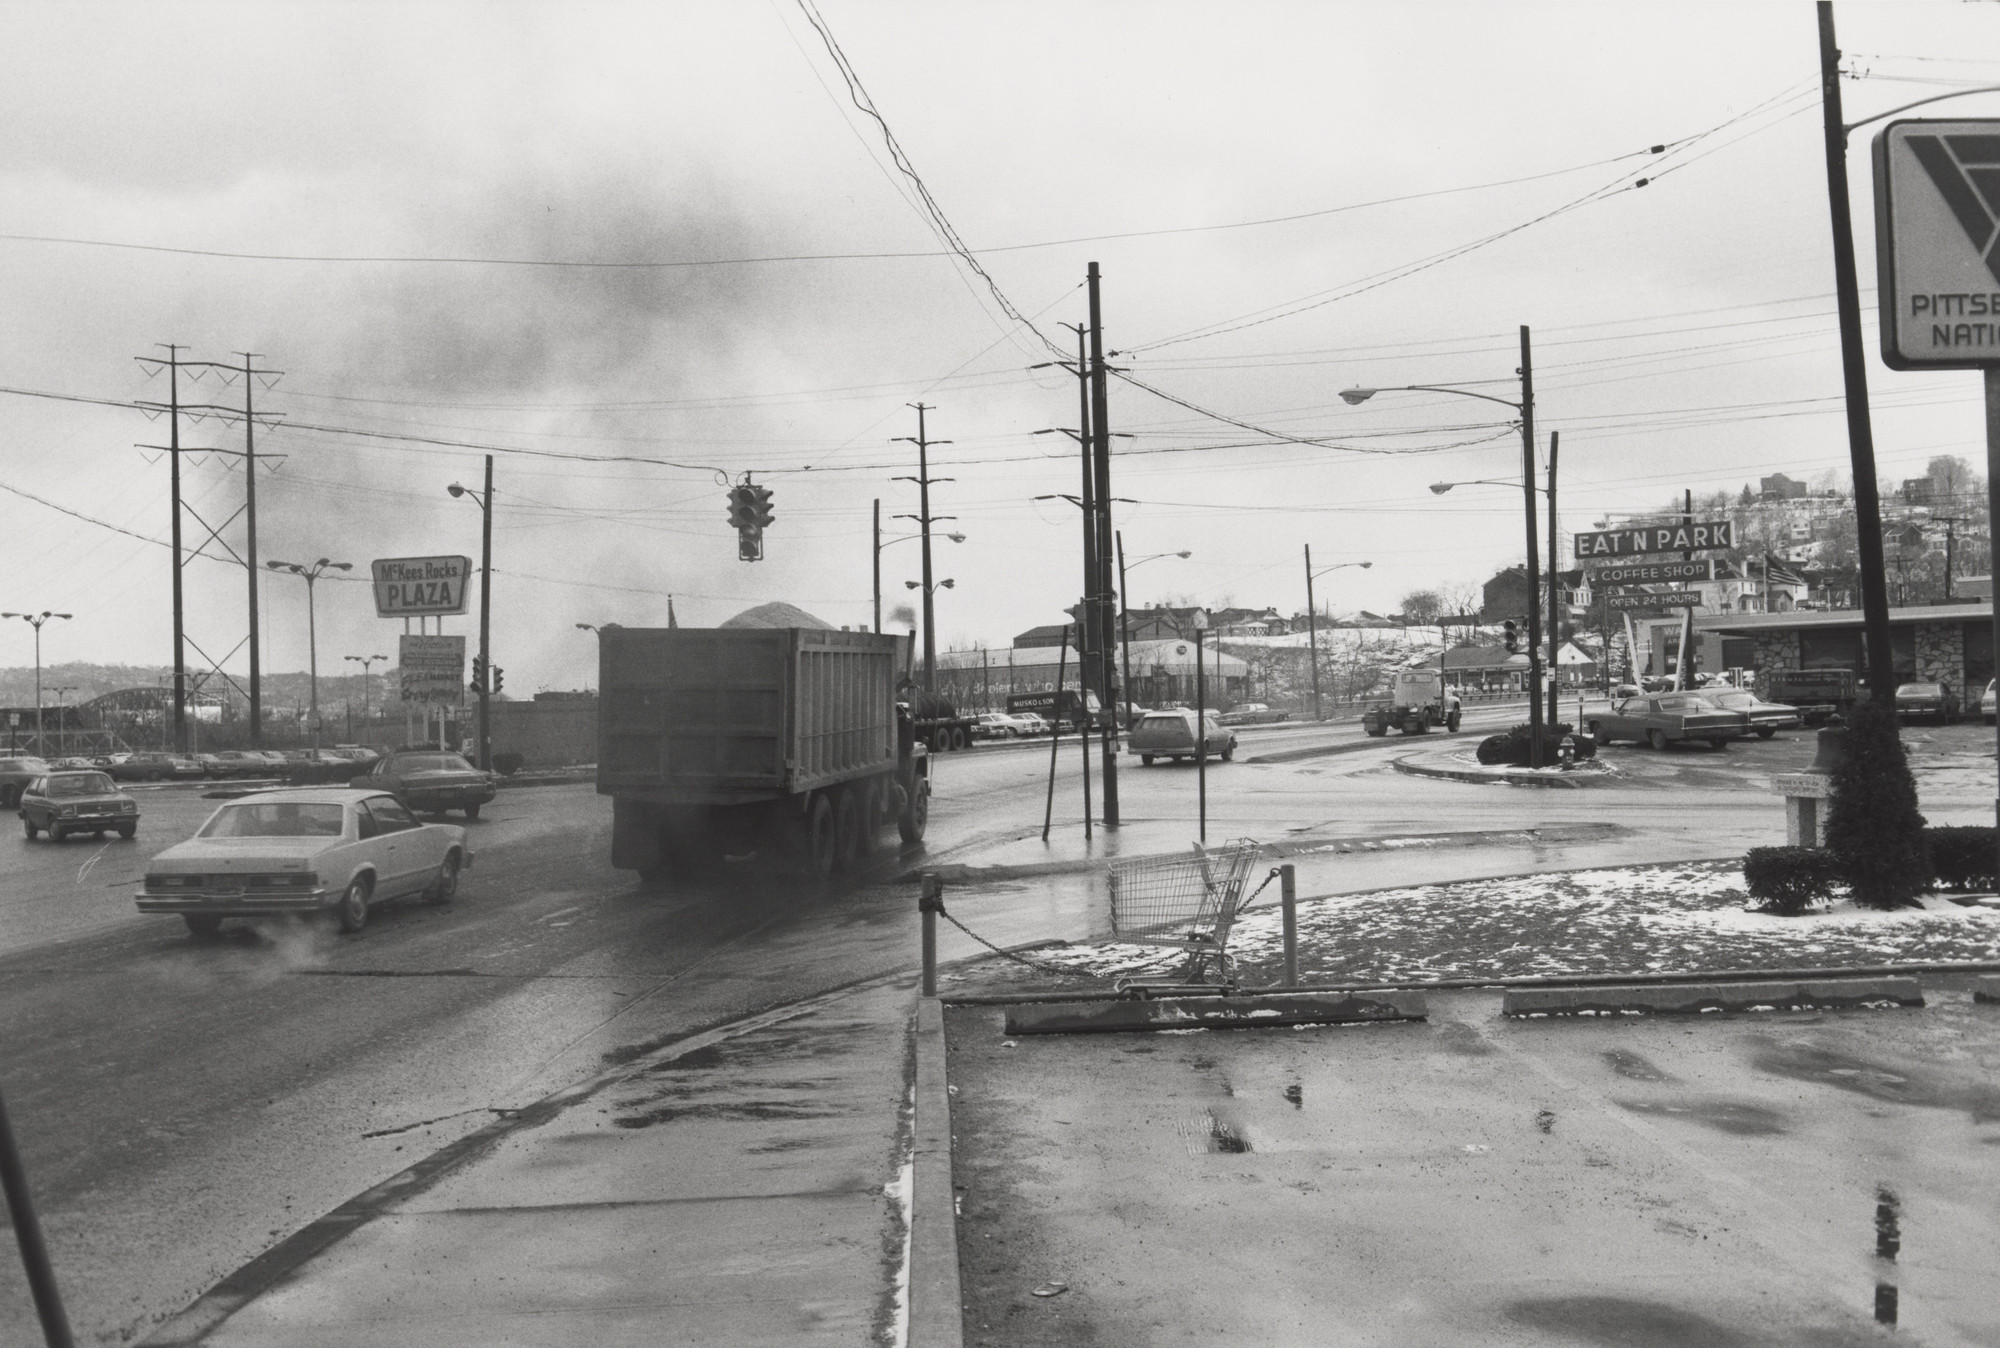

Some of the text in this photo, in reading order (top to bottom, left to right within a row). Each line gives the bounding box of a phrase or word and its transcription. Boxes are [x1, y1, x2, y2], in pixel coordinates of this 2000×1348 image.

[1932, 323, 2000, 346] NATI
[1578, 524, 1728, 555] EAT'N PARK
[380, 561, 458, 580] McKees Rocks
[1601, 564, 1705, 581] COFFEE SHOP
[387, 581, 452, 607] PLAZA
[1609, 593, 1699, 608] OPEN 24 HOURS
[1013, 698, 1038, 708] MUSKO
[1042, 697, 1055, 706] SON
